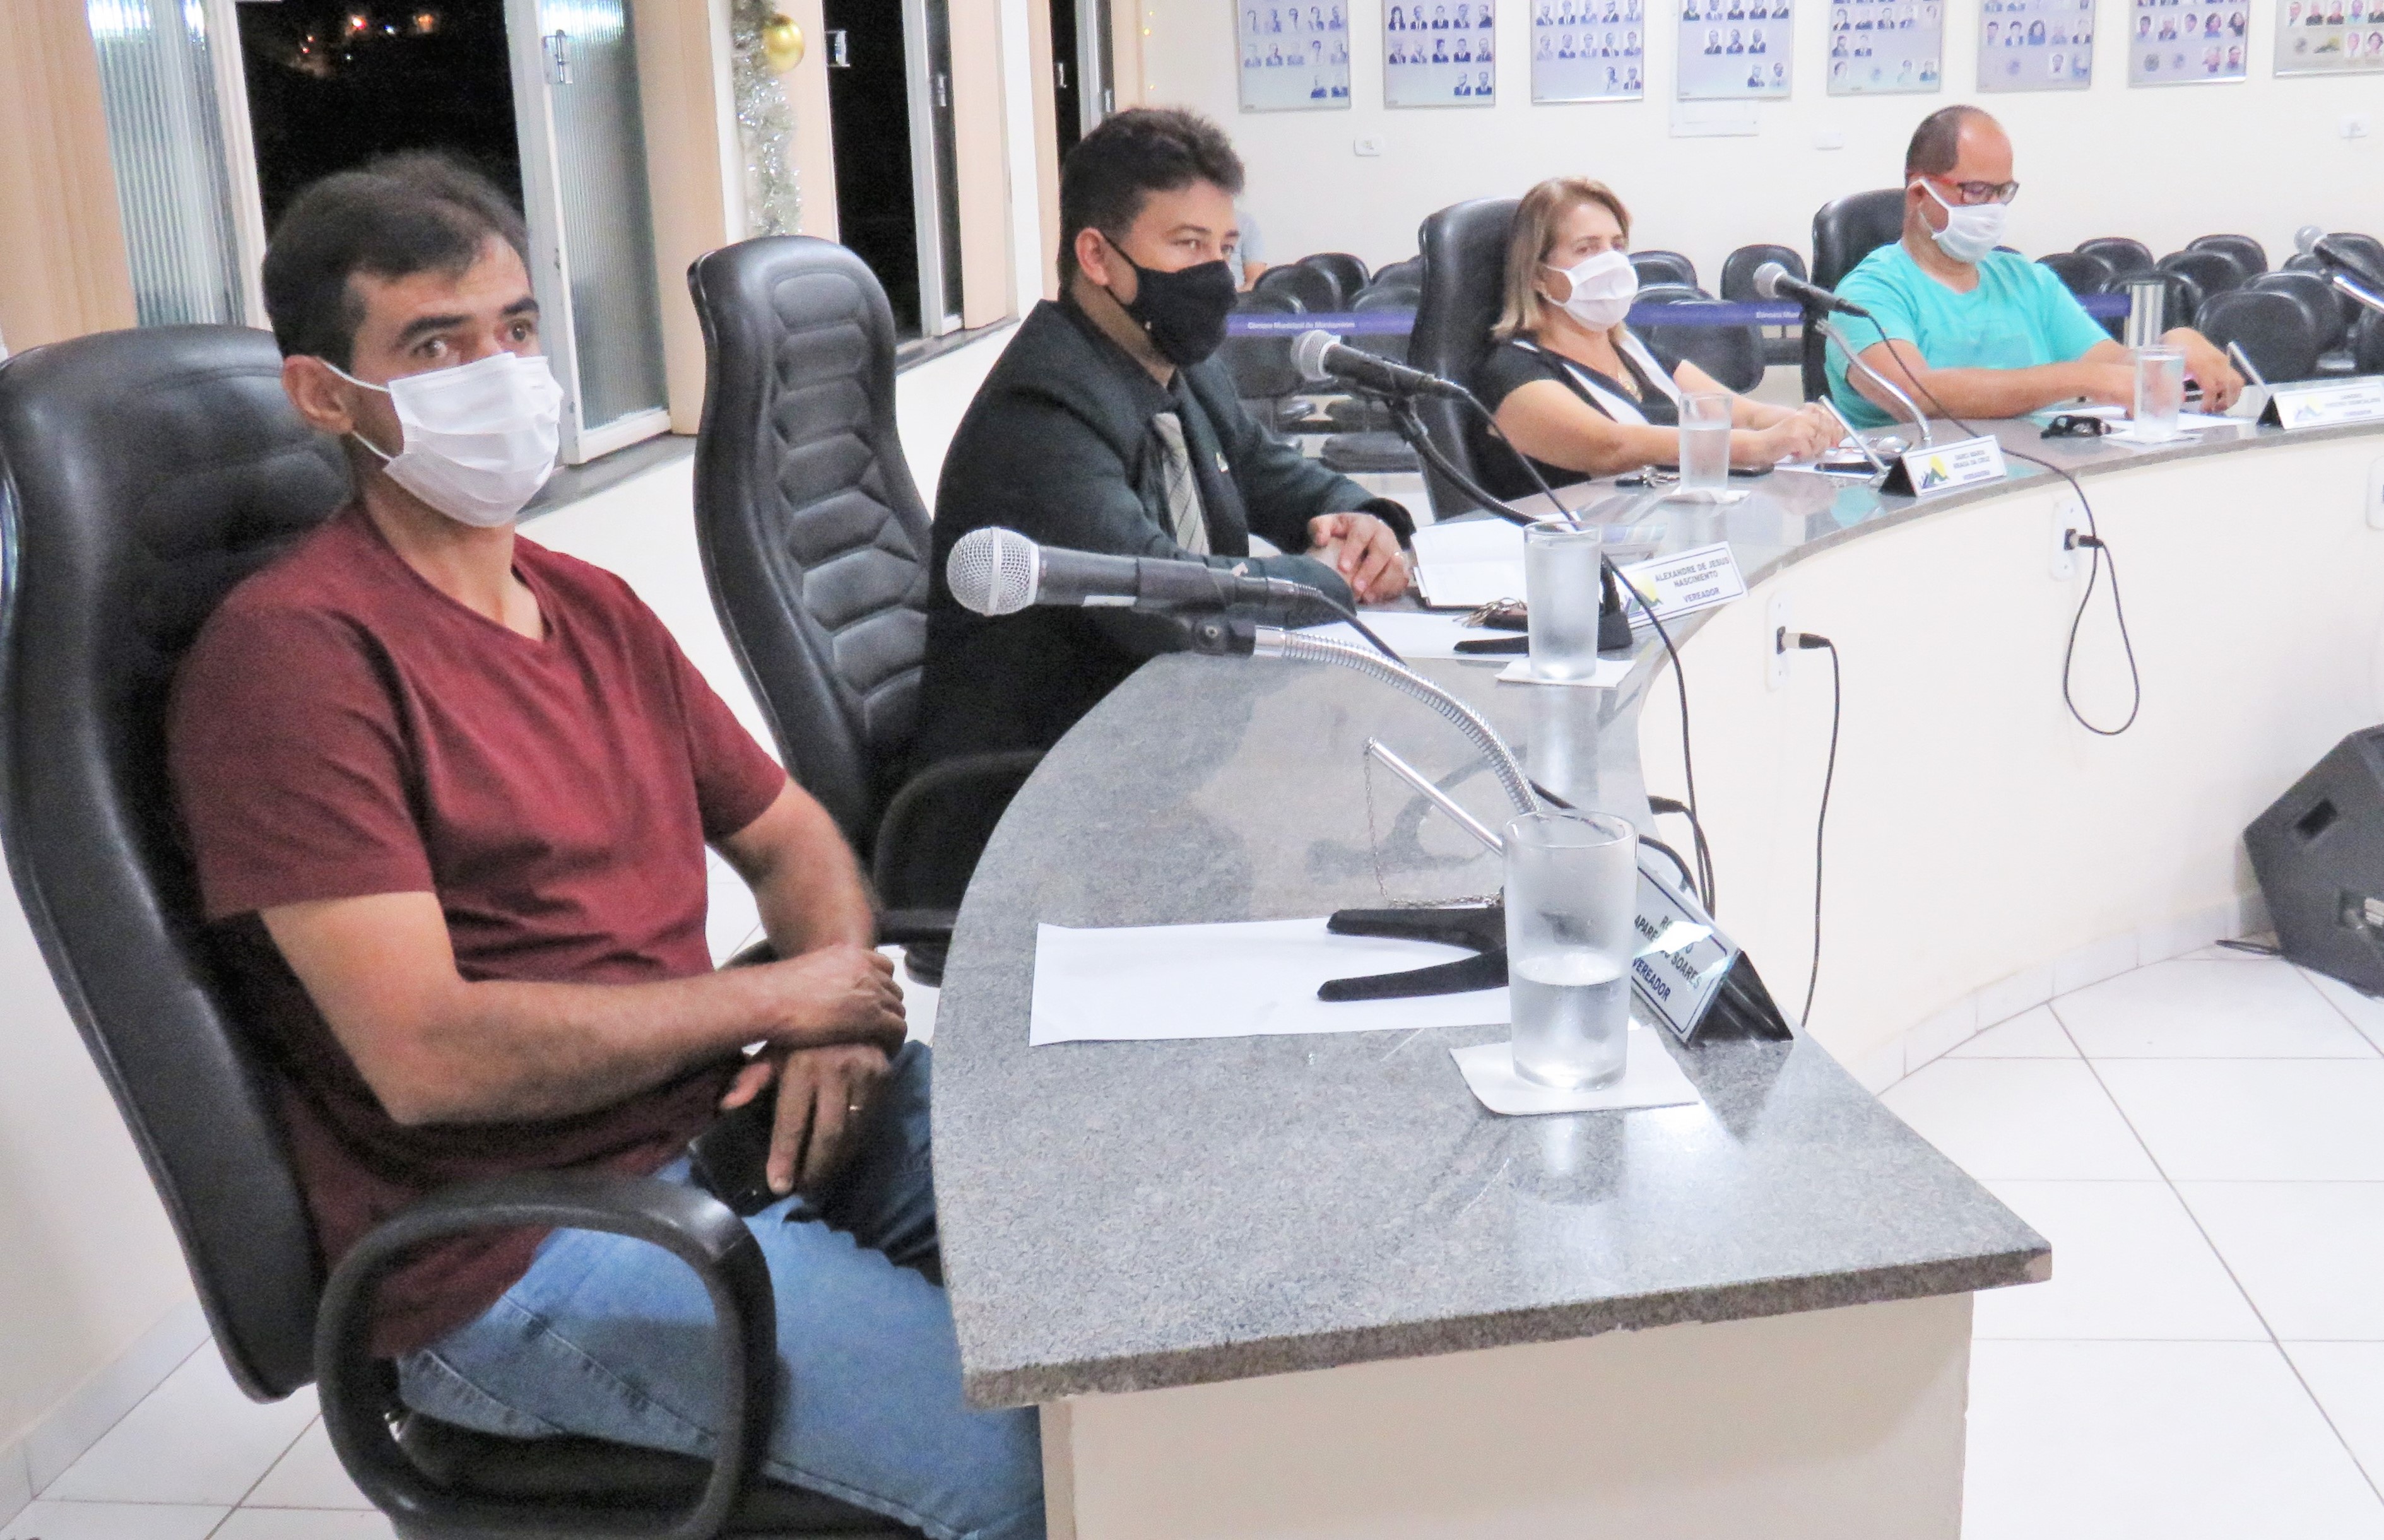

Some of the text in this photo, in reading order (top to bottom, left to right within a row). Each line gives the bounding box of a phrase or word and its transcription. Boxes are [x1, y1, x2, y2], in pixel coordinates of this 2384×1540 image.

[1655, 556, 1730, 582] ALEXANDRE DE JESUS
[1673, 570, 1718, 588] NASCIMENTO
[1682, 587, 1720, 603] VEREADOR
[1632, 956, 1671, 1002] VEREADOR
[1671, 951, 1702, 989] SOARES
